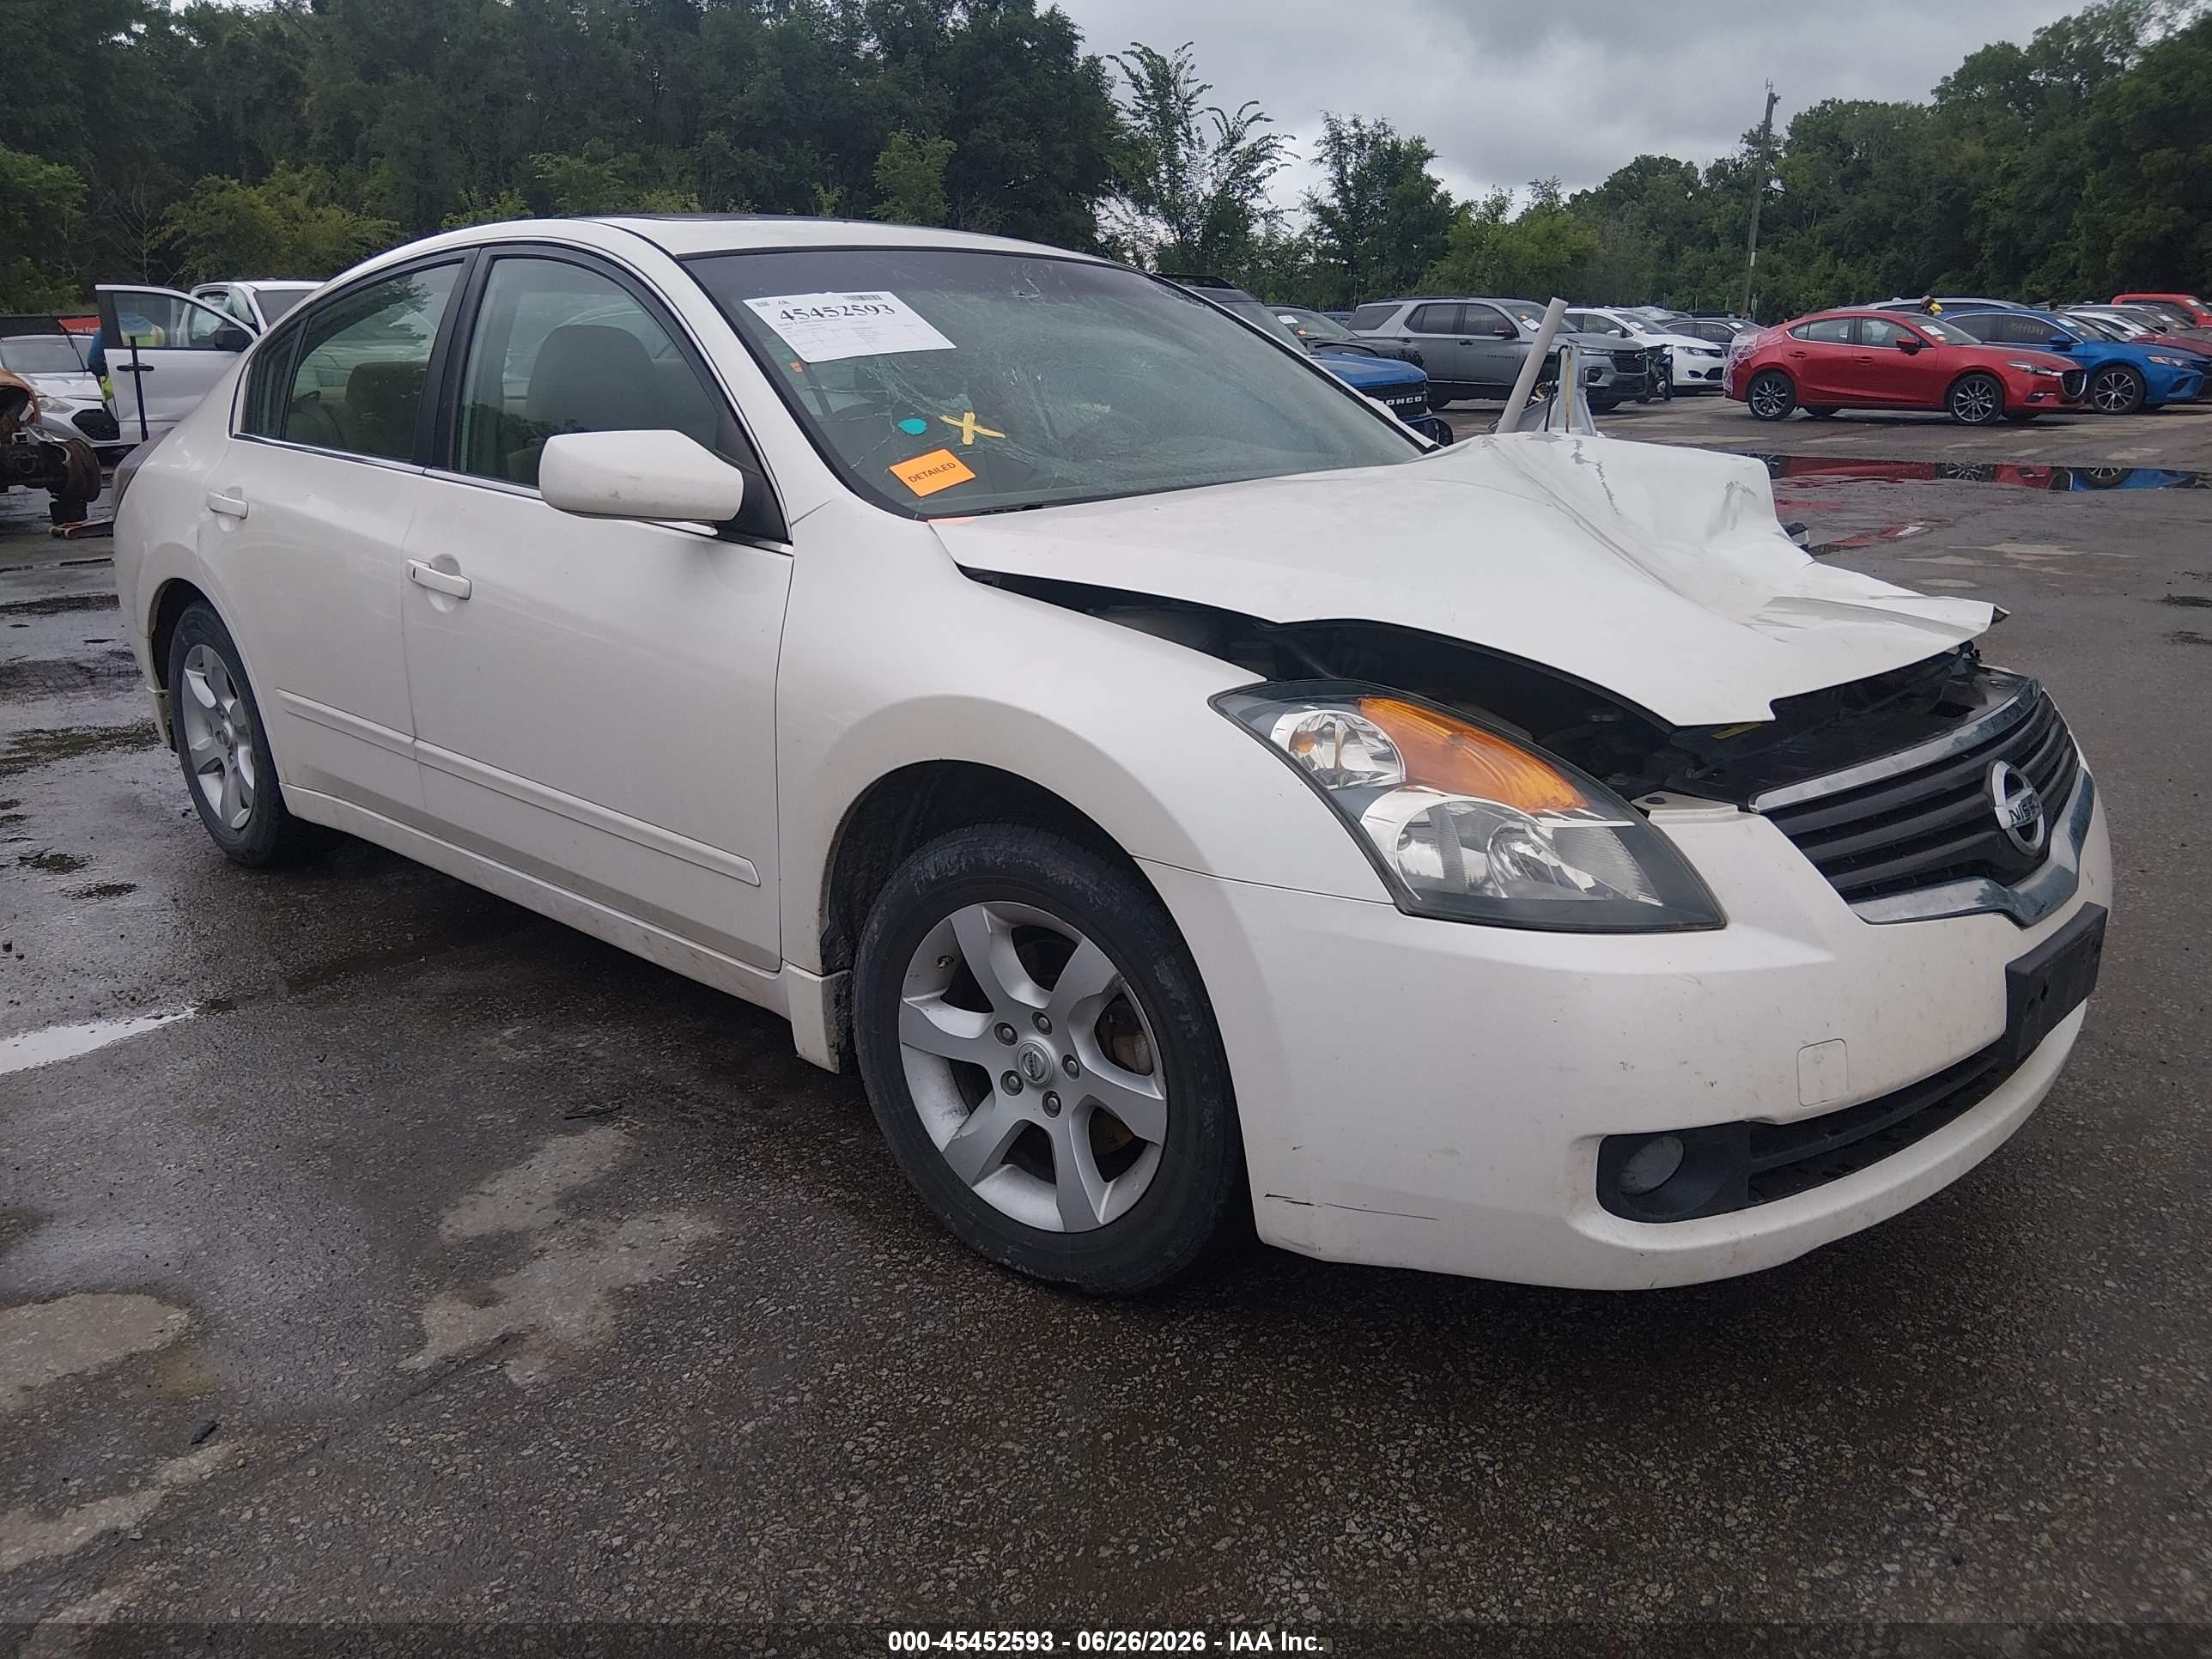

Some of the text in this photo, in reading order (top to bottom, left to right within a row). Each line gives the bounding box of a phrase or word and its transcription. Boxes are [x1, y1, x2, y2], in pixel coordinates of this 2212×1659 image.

[780, 304, 896, 320] 45452593
[1384, 396, 1423, 406] ONCO
[907, 462, 957, 483] DETAILED
